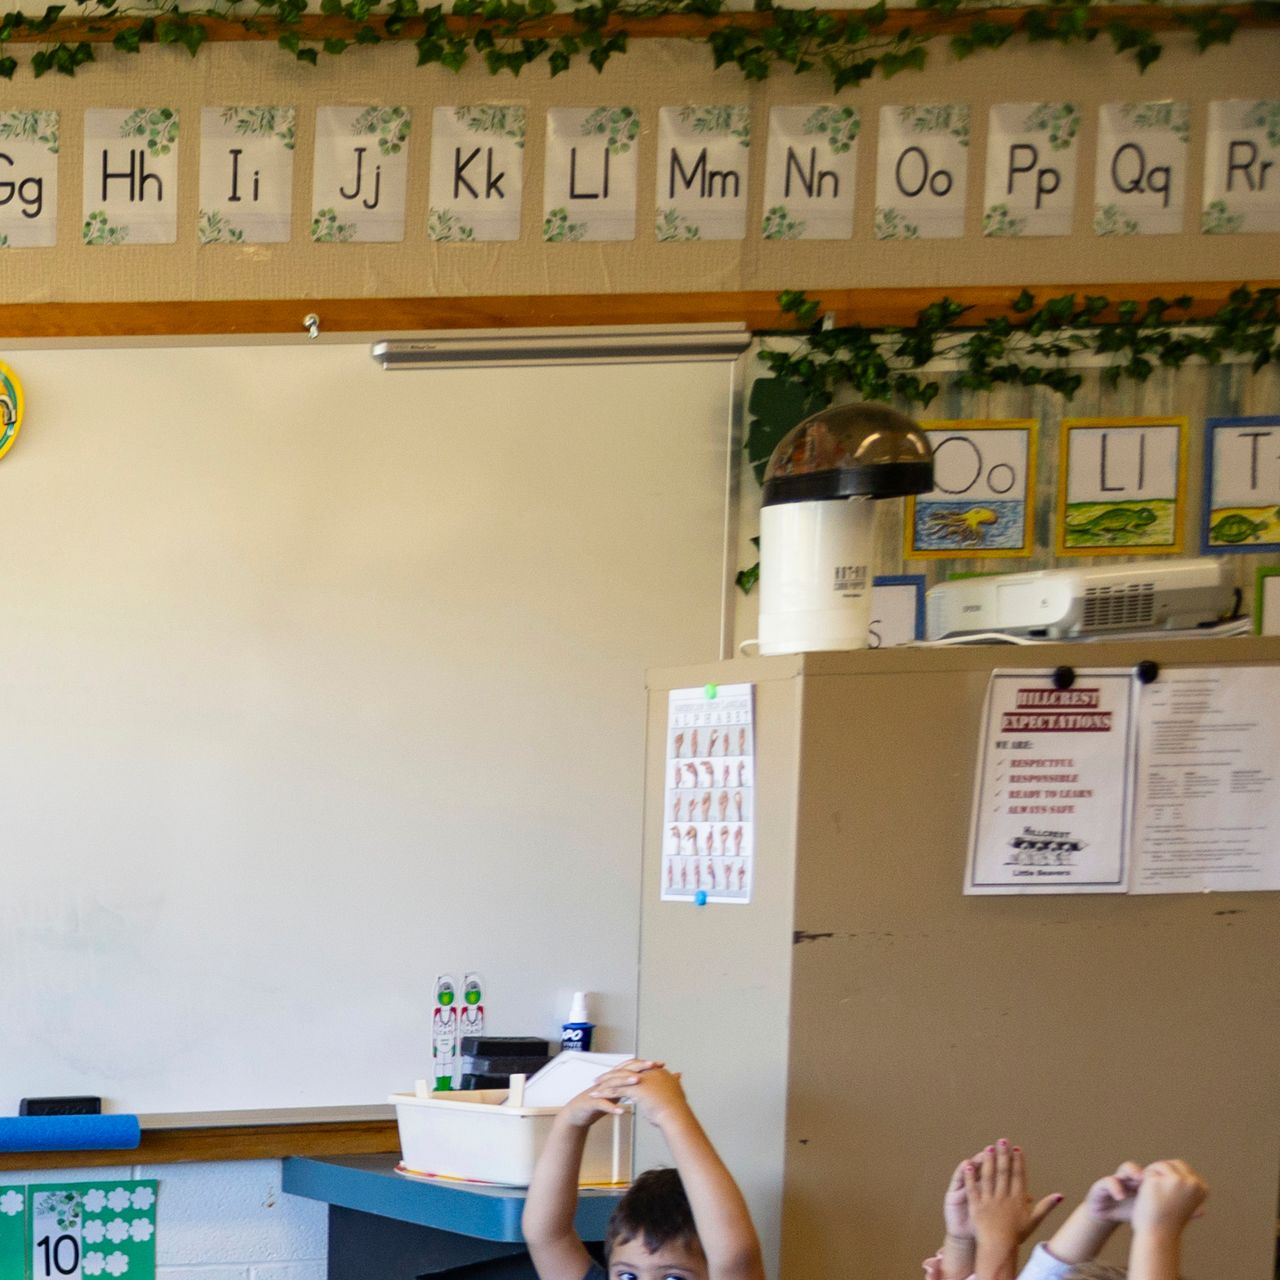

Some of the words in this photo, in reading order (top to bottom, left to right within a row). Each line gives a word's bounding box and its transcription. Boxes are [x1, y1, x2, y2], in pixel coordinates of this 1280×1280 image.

[102, 149, 163, 203] Hh
[340, 147, 382, 210] Jj
[453, 146, 506, 200] Kk
[669, 147, 739, 199] Mm
[784, 146, 839, 198] Nn
[895, 146, 953, 198] Oo
[1007, 143, 1060, 210] Pp
[1110, 142, 1172, 208] Qq
[1225, 140, 1274, 191] Rr
[1238, 432, 1280, 490] T
[1001, 711, 1112, 732] EXPECTATIONS
[1016, 689, 1099, 709] HILLCREST
[37, 1235, 81, 1277] 10
